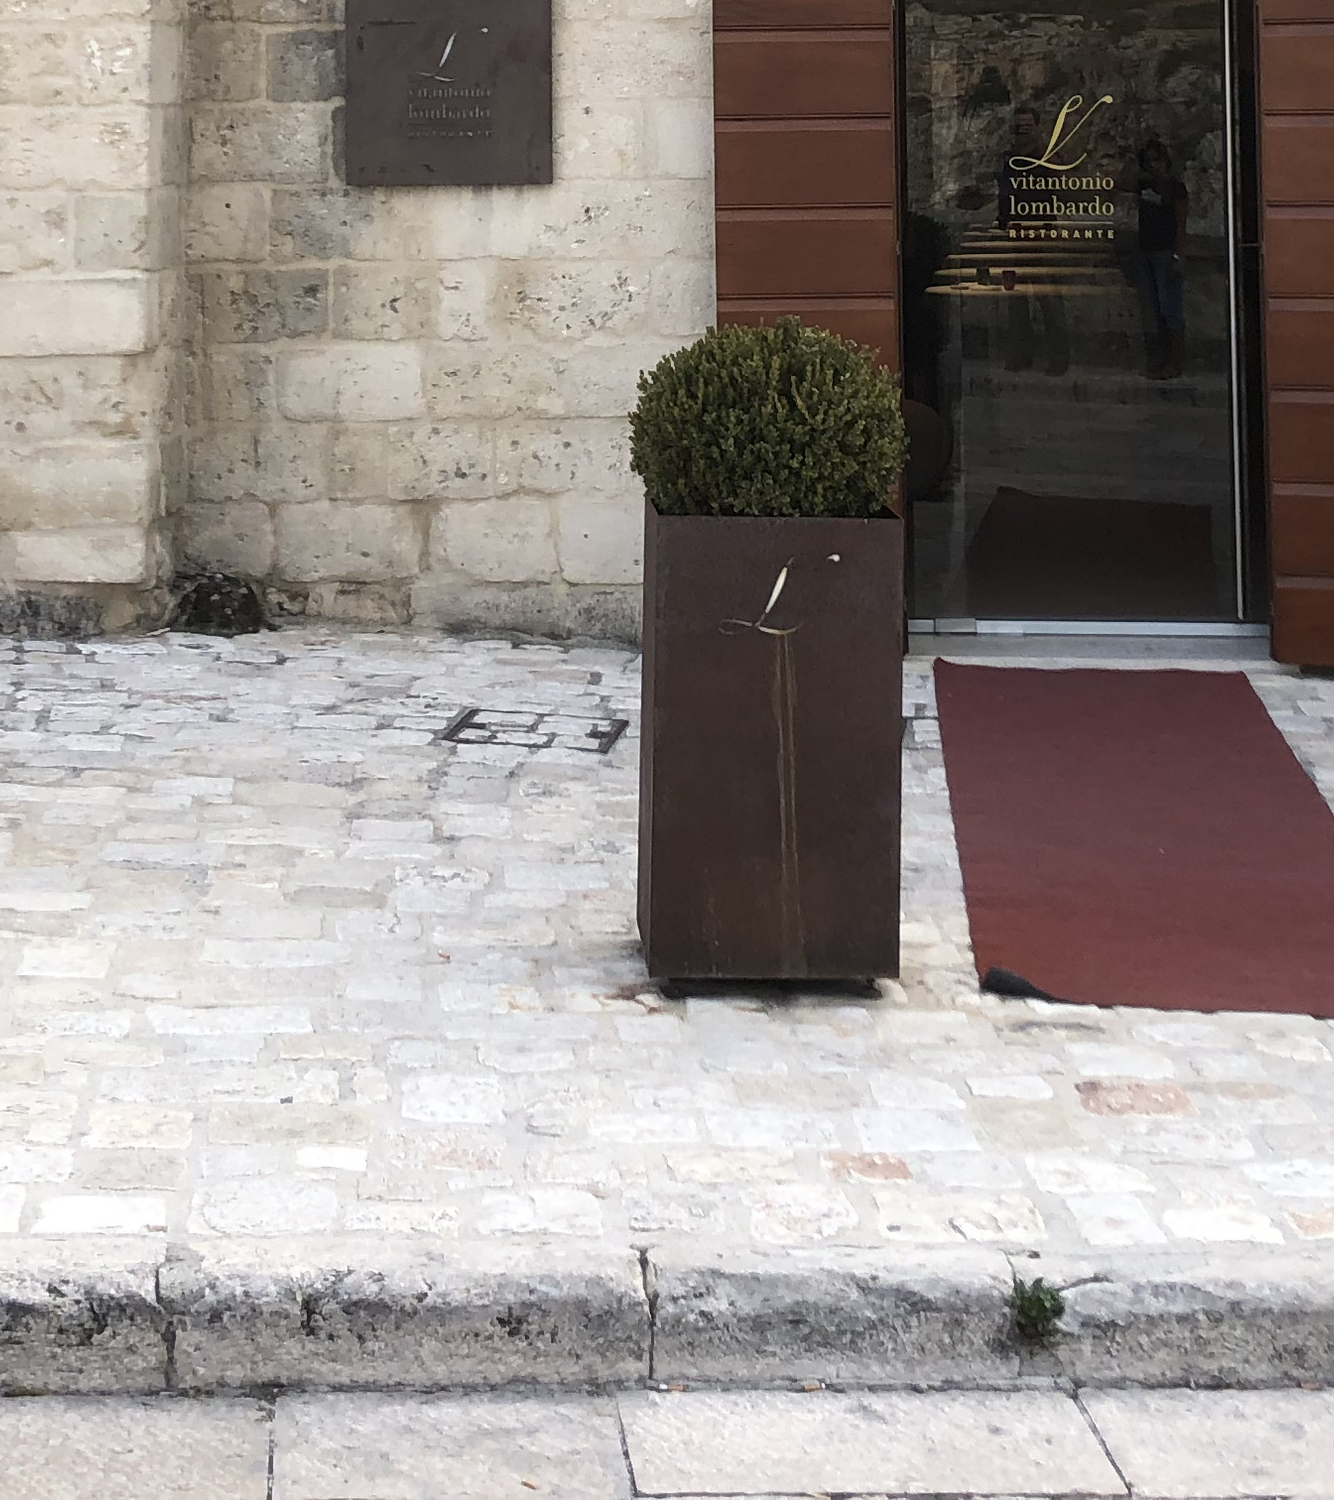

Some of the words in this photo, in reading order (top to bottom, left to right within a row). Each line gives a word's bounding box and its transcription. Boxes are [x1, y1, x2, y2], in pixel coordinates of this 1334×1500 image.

[1008, 172, 1115, 191] vitantonio
[1008, 195, 1115, 217] lombardo
[1008, 229, 1115, 240] RISTORANTE
